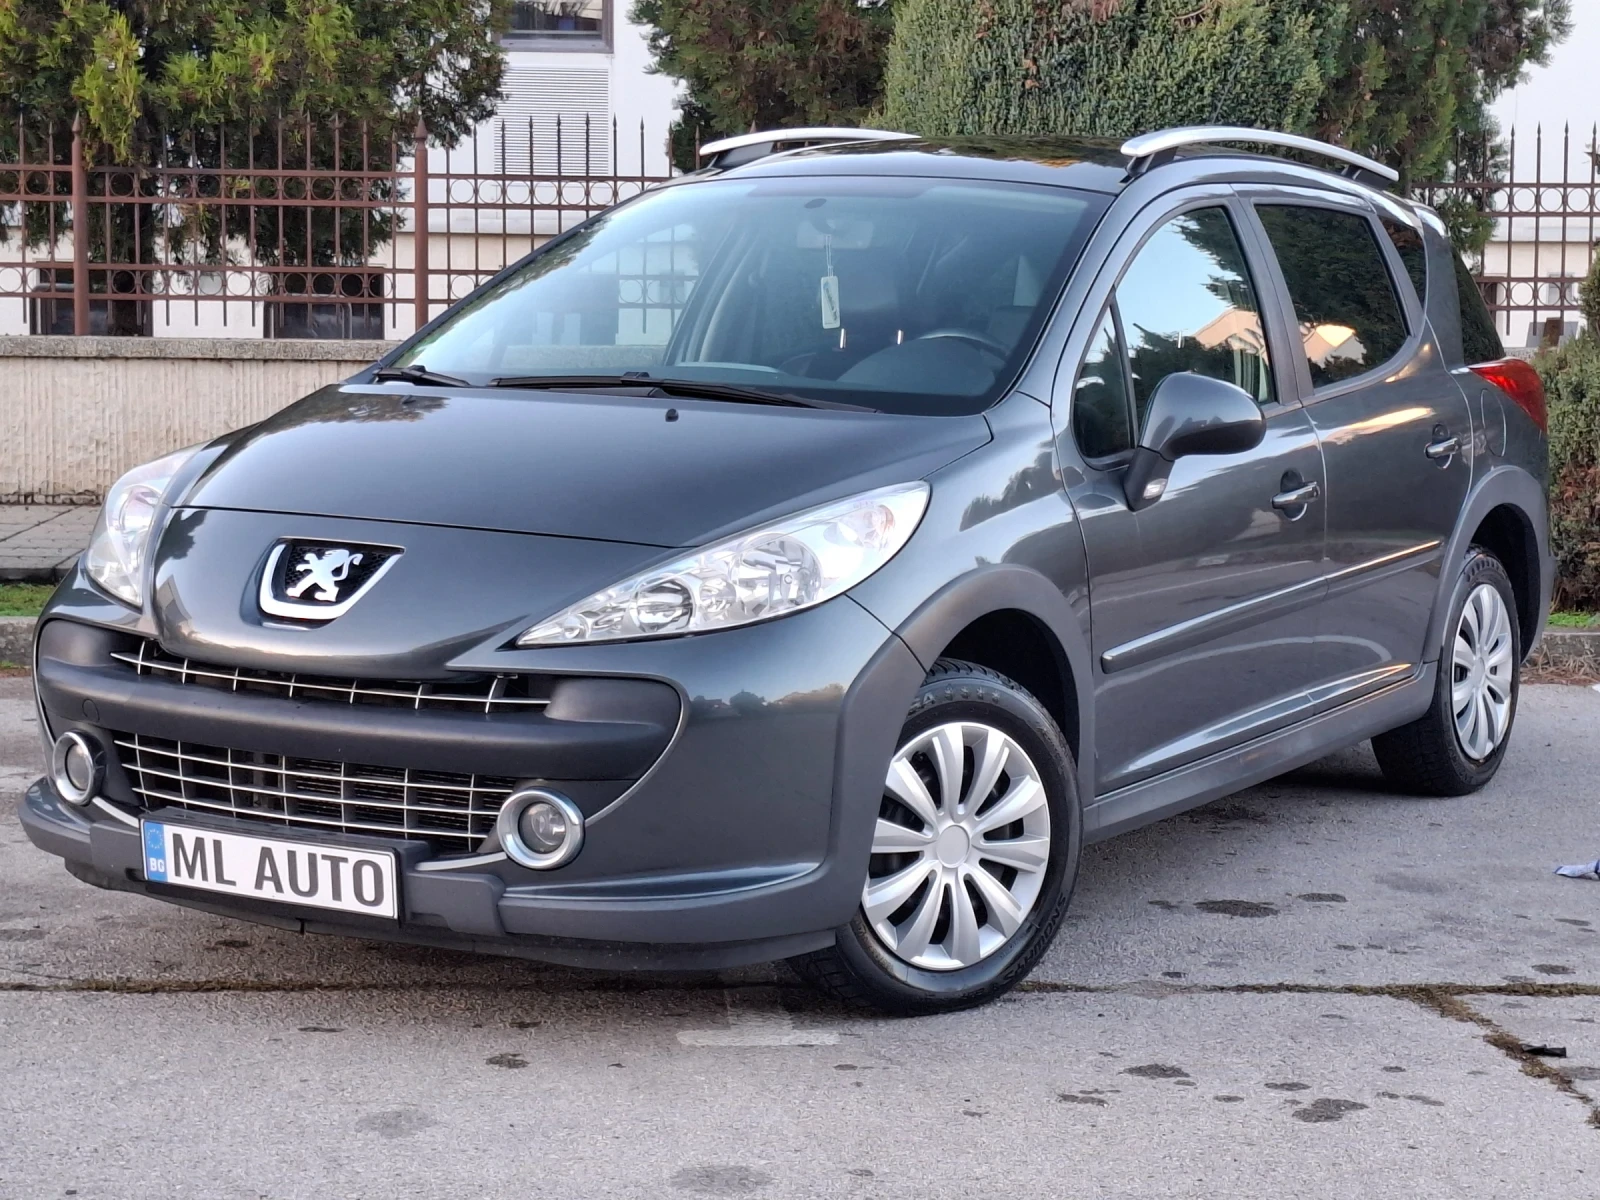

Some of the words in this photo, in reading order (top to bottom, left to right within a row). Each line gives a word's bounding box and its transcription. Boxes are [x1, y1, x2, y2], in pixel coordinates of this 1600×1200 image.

[150, 857, 165, 873] BG
[172, 833, 237, 887] ML
[254, 846, 385, 907] AUTO
